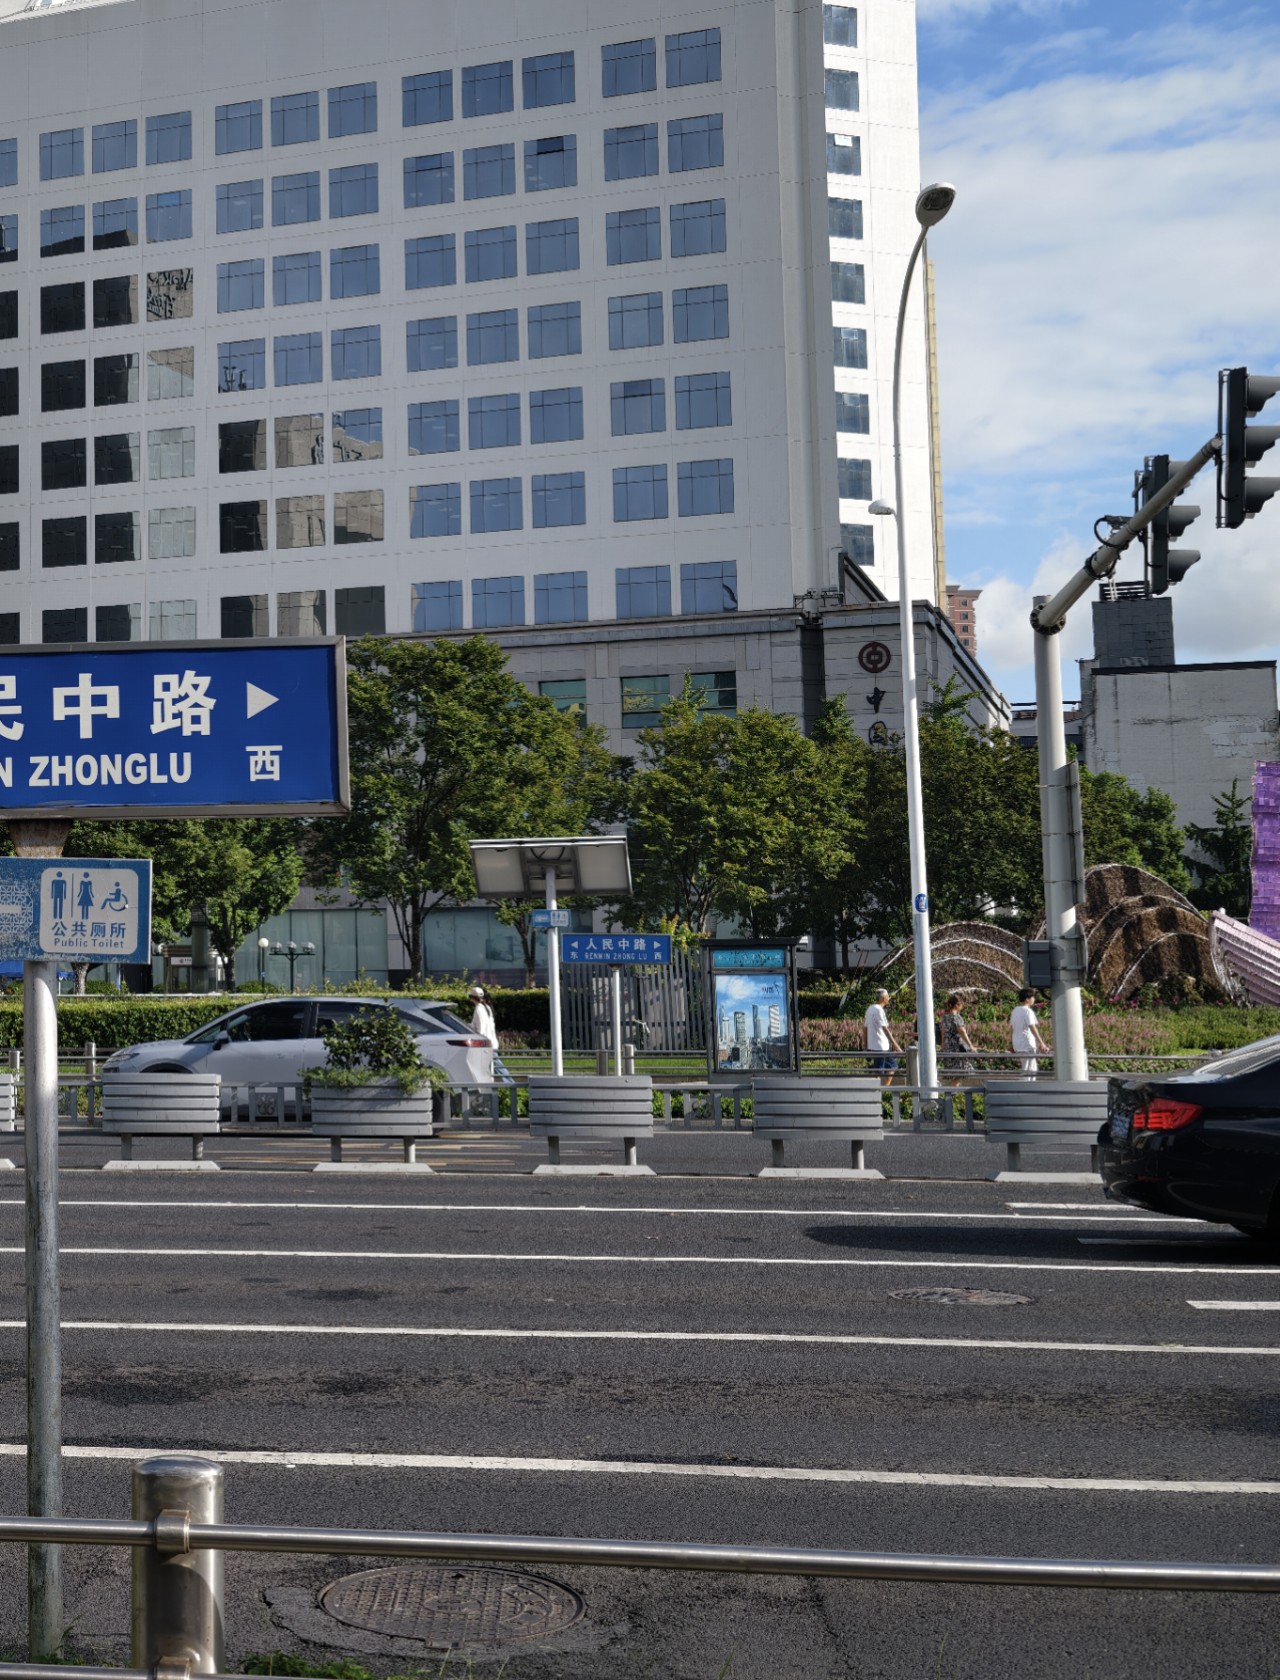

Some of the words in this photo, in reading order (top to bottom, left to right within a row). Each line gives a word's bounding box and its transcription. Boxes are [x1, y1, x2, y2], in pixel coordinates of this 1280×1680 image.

[28, 752, 192, 787] ZHONGLU
[245, 745, 283, 782] 西
[52, 920, 126, 939] 公共厕所
[54, 937, 88, 948] Public
[91, 938, 124, 949] Toilet
[585, 938, 647, 950] 人民中路
